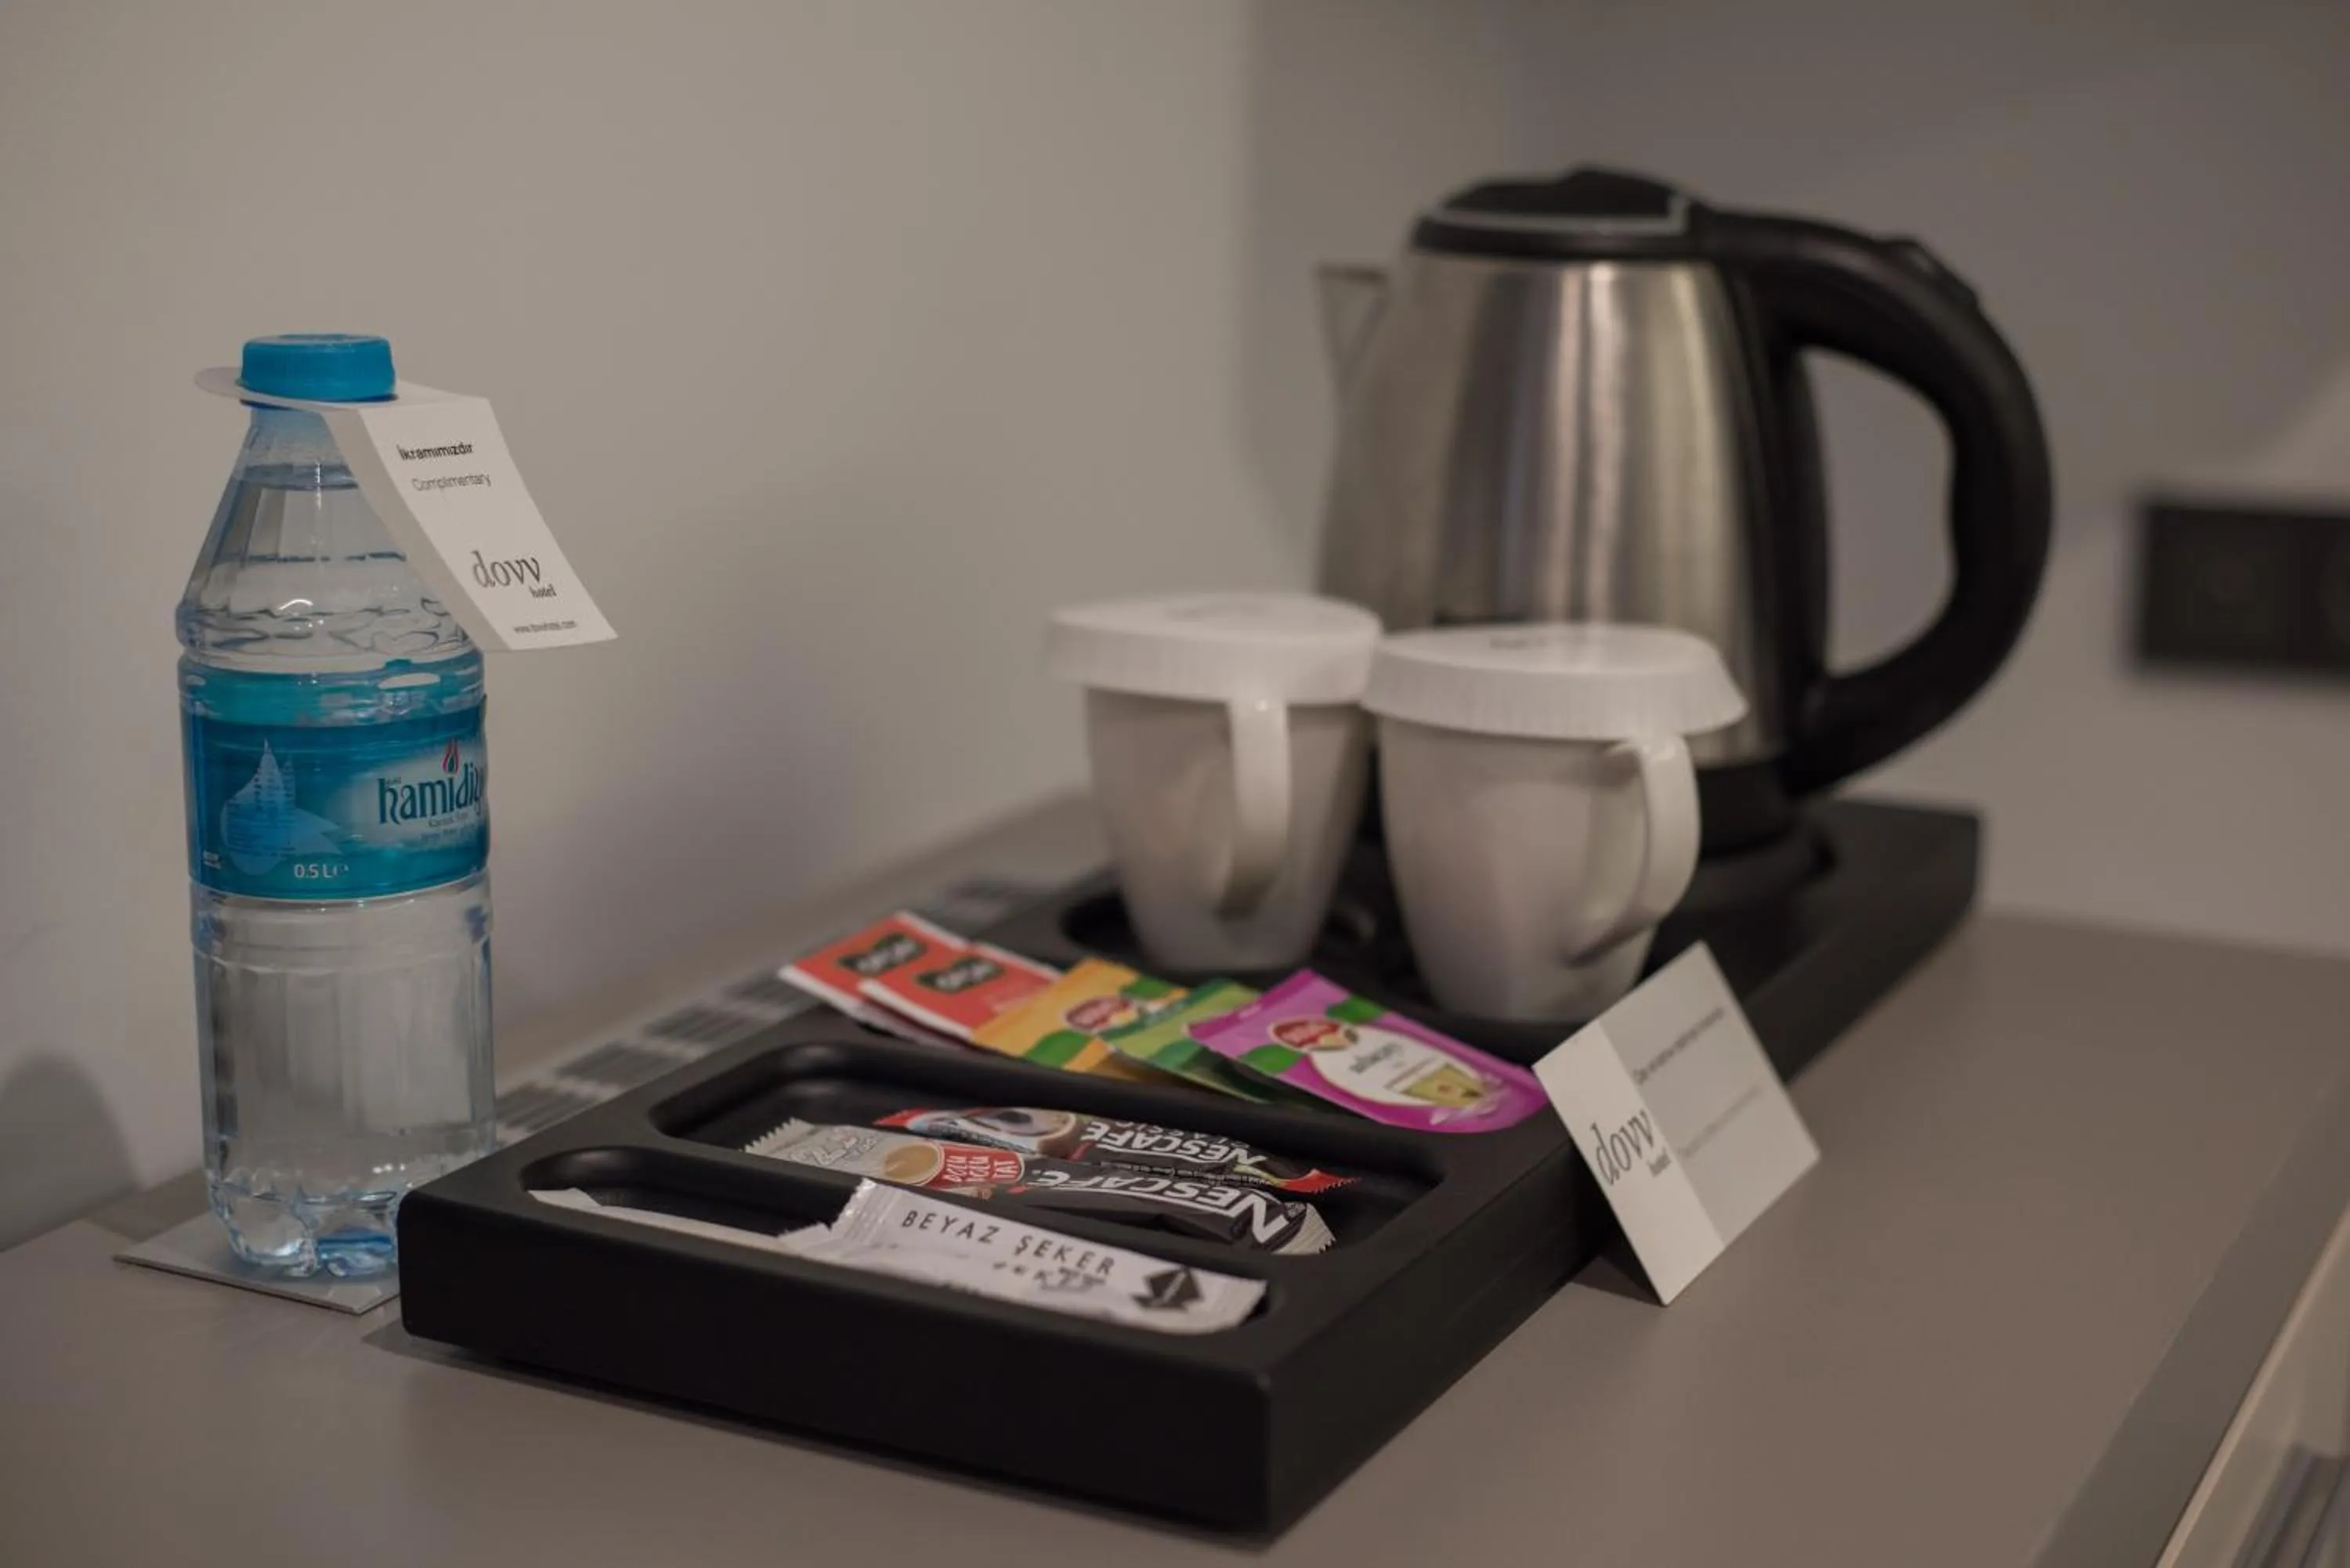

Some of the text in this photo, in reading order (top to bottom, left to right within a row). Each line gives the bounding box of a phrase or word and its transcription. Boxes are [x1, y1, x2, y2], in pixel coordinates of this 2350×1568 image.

[378, 762, 483, 826] hamidiy
[902, 1209, 1001, 1245] BEYAZ
[1014, 1234, 1116, 1277] ŞEKER
